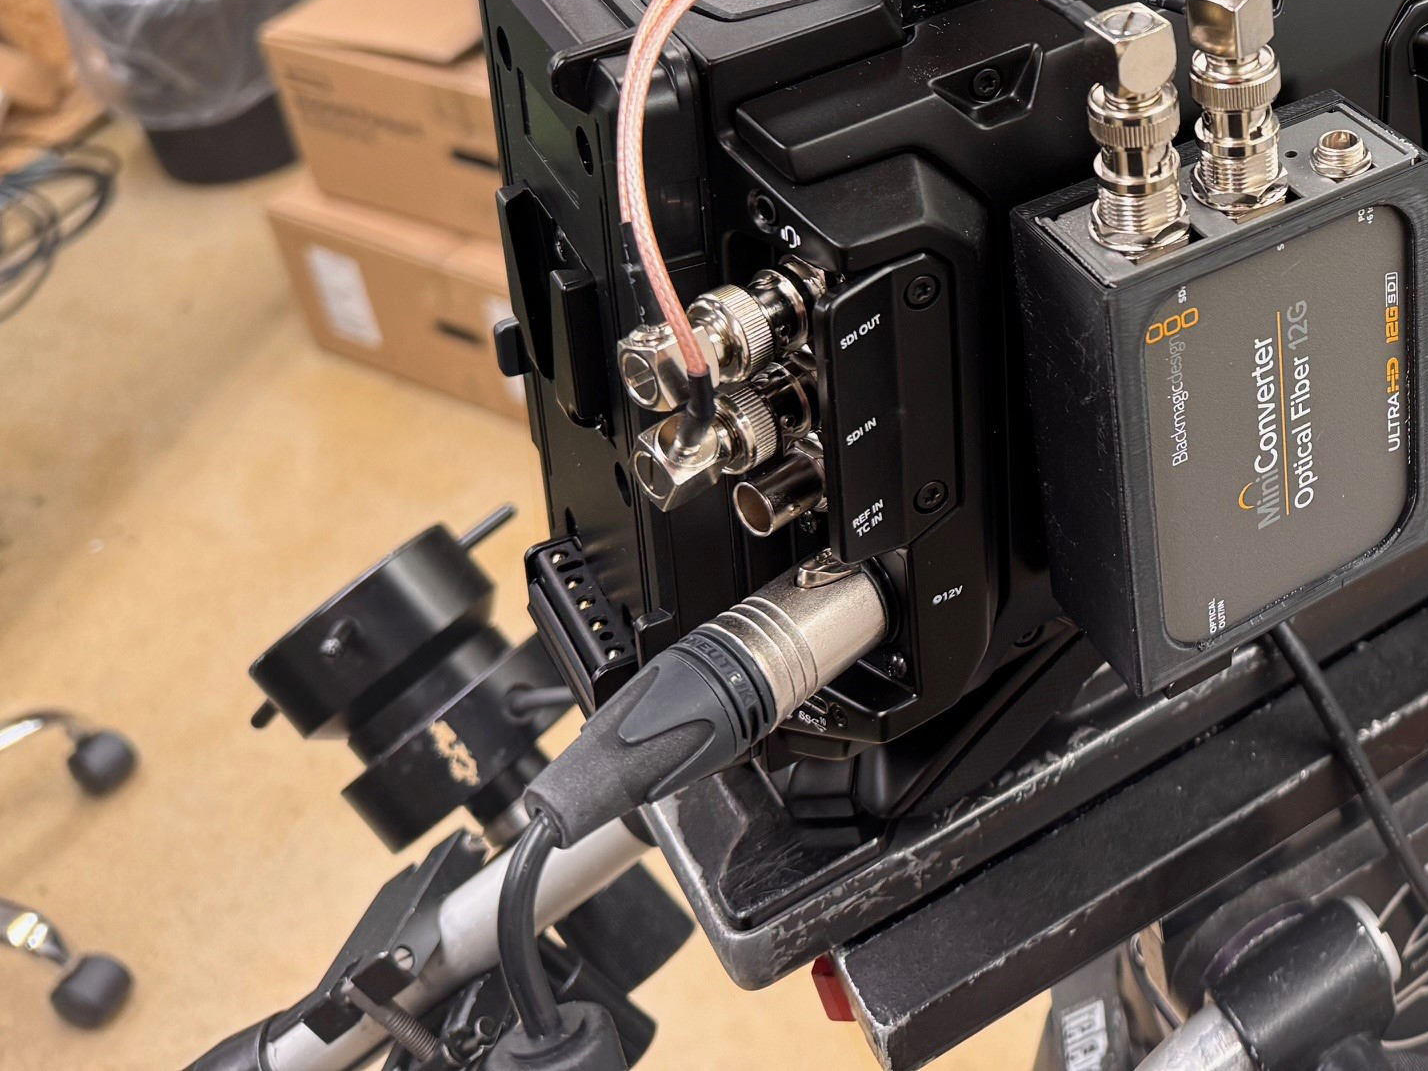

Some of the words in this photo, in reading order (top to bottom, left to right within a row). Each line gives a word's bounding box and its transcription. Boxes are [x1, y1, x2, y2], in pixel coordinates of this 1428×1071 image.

[840, 331, 858, 349] SDI
[859, 314, 881, 336] OUT
[1287, 300, 1309, 350] 12G
[1167, 334, 1189, 466] Blackmagicdesign
[1290, 356, 1311, 421] Fiber
[846, 427, 864, 446] SDI
[864, 417, 877, 432] IN
[1251, 337, 1281, 530] MiniConverter
[1292, 422, 1318, 509] Optical
[852, 508, 871, 529] REF
[871, 498, 884, 513] IN
[856, 522, 871, 537] TC
[871, 512, 883, 527] IN
[1208, 598, 1217, 634] OPTICAL
[1217, 599, 1226, 629] OUT/IN
[682, 636, 757, 709] NEUTRIK
